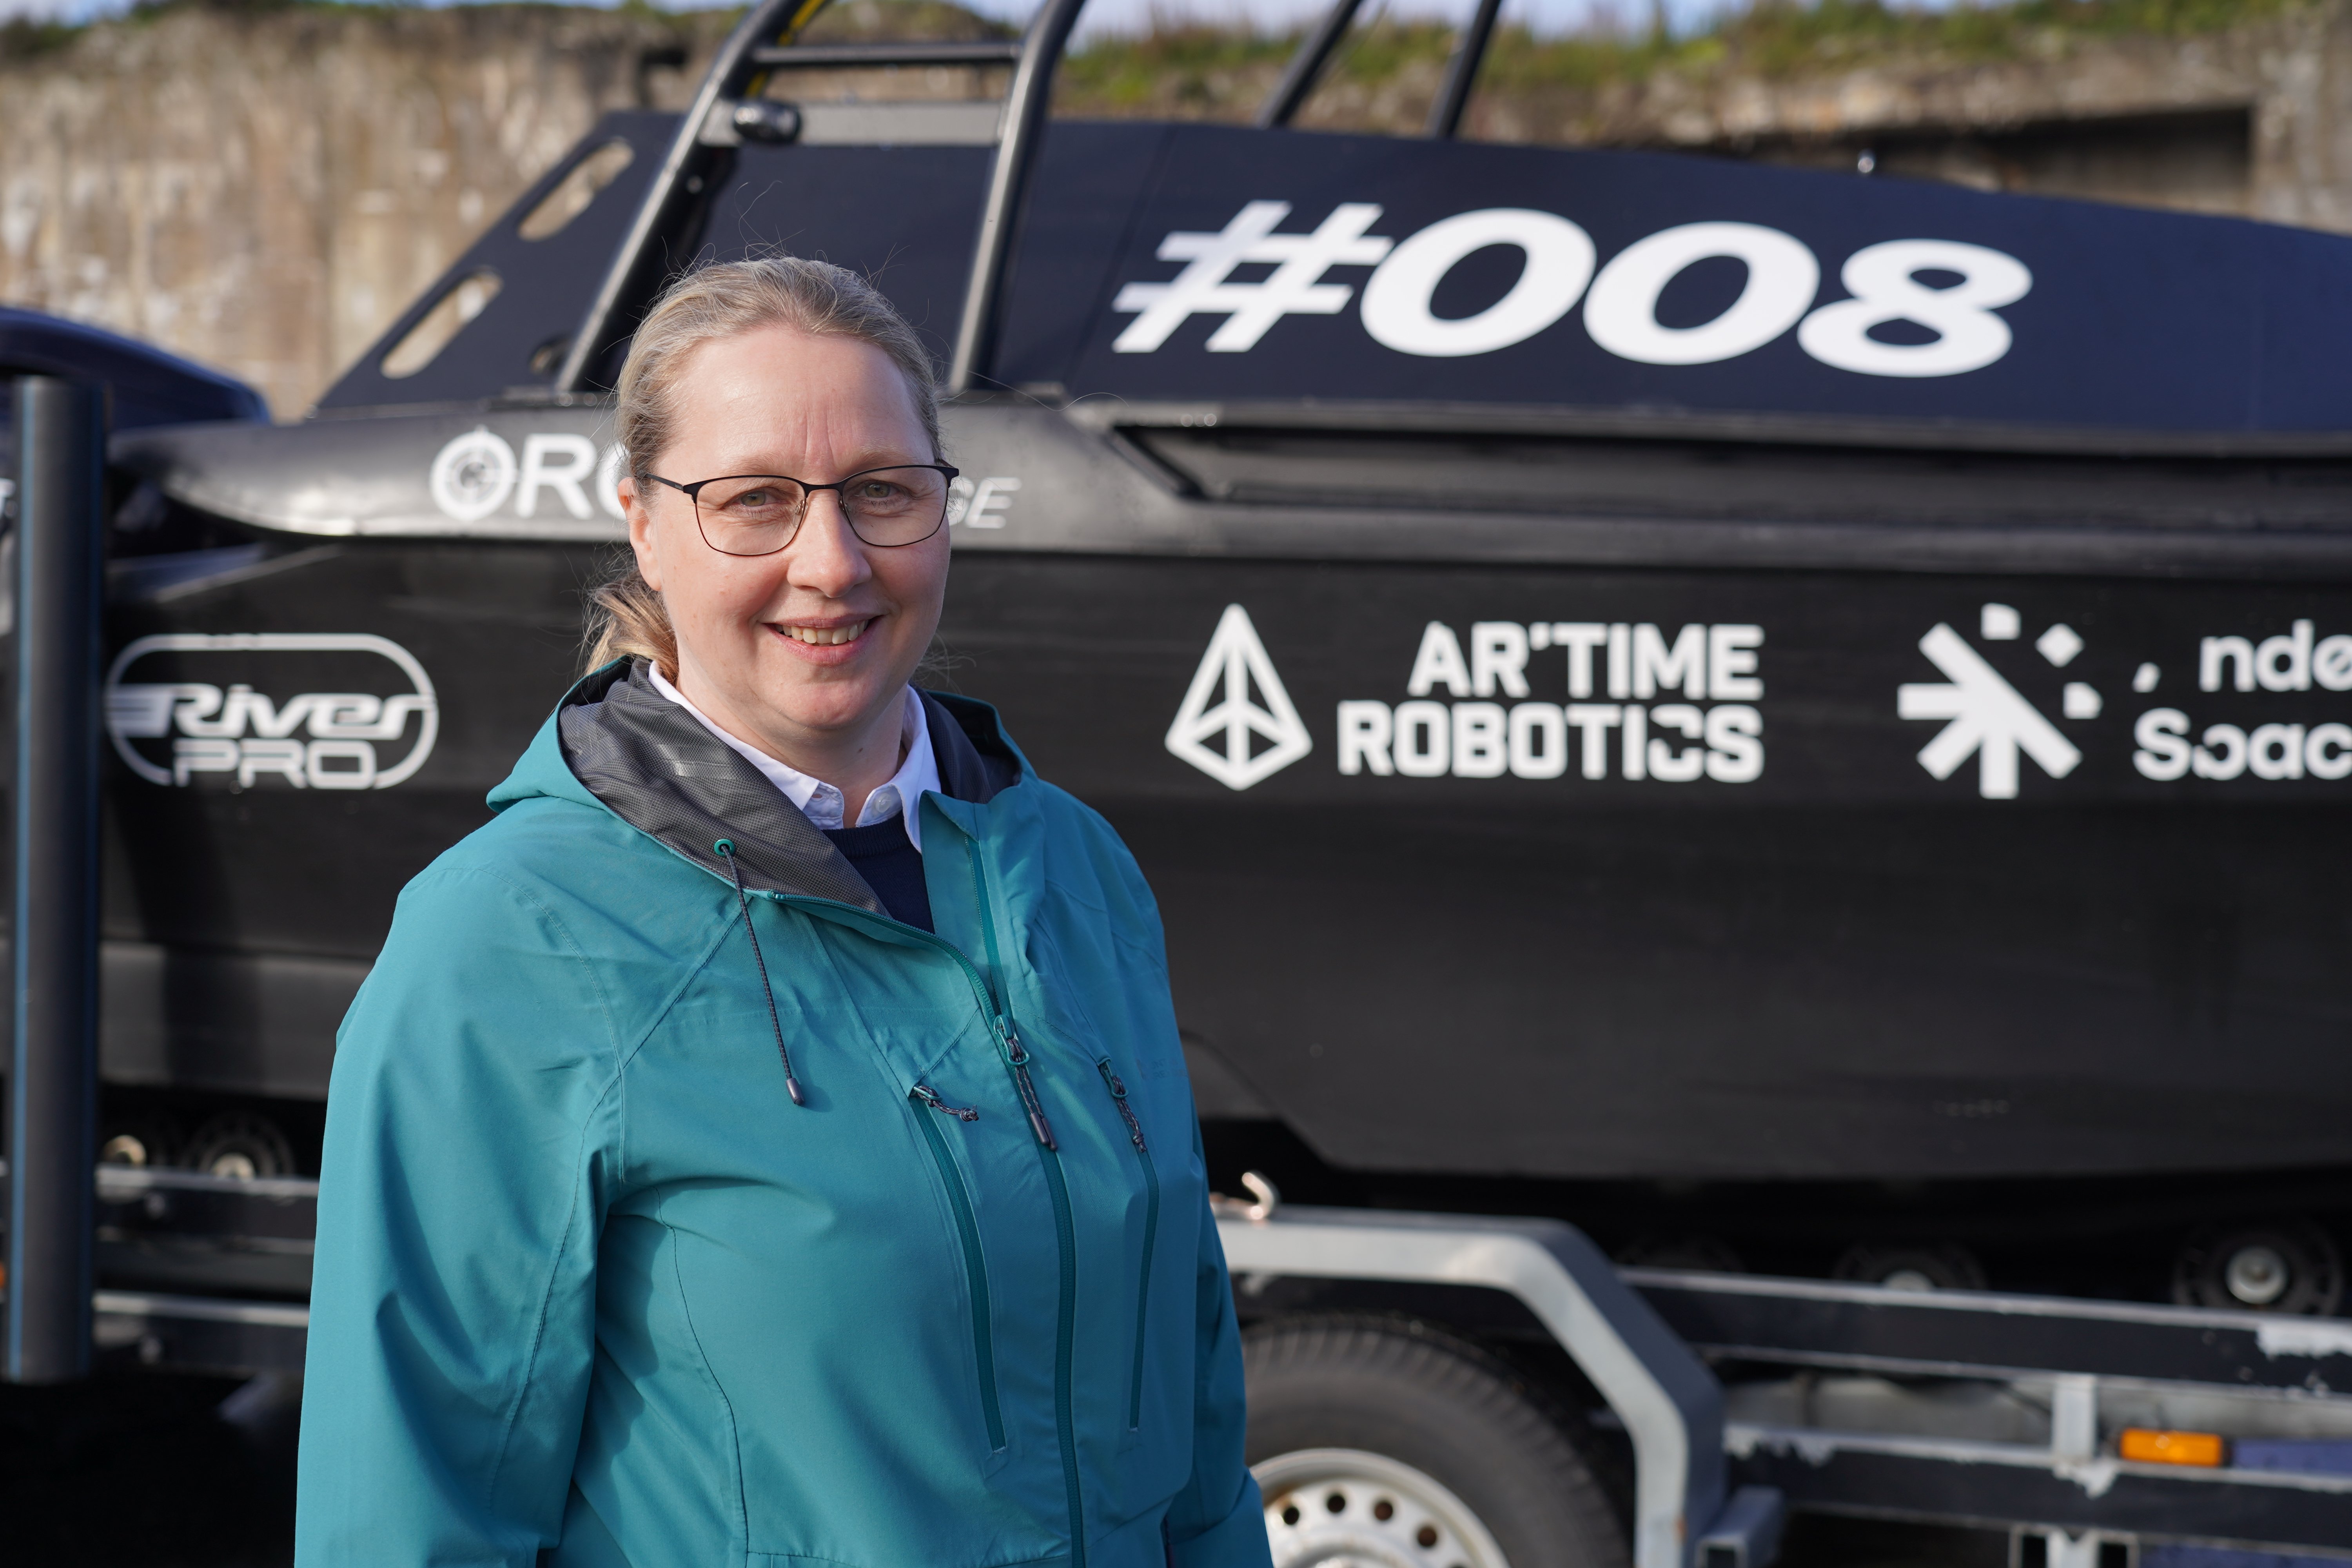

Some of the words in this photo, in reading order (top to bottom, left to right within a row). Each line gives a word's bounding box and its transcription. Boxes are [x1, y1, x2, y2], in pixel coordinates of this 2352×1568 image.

[1112, 200, 2033, 378] #008
[108, 682, 436, 740] River
[173, 739, 377, 790] PRO
